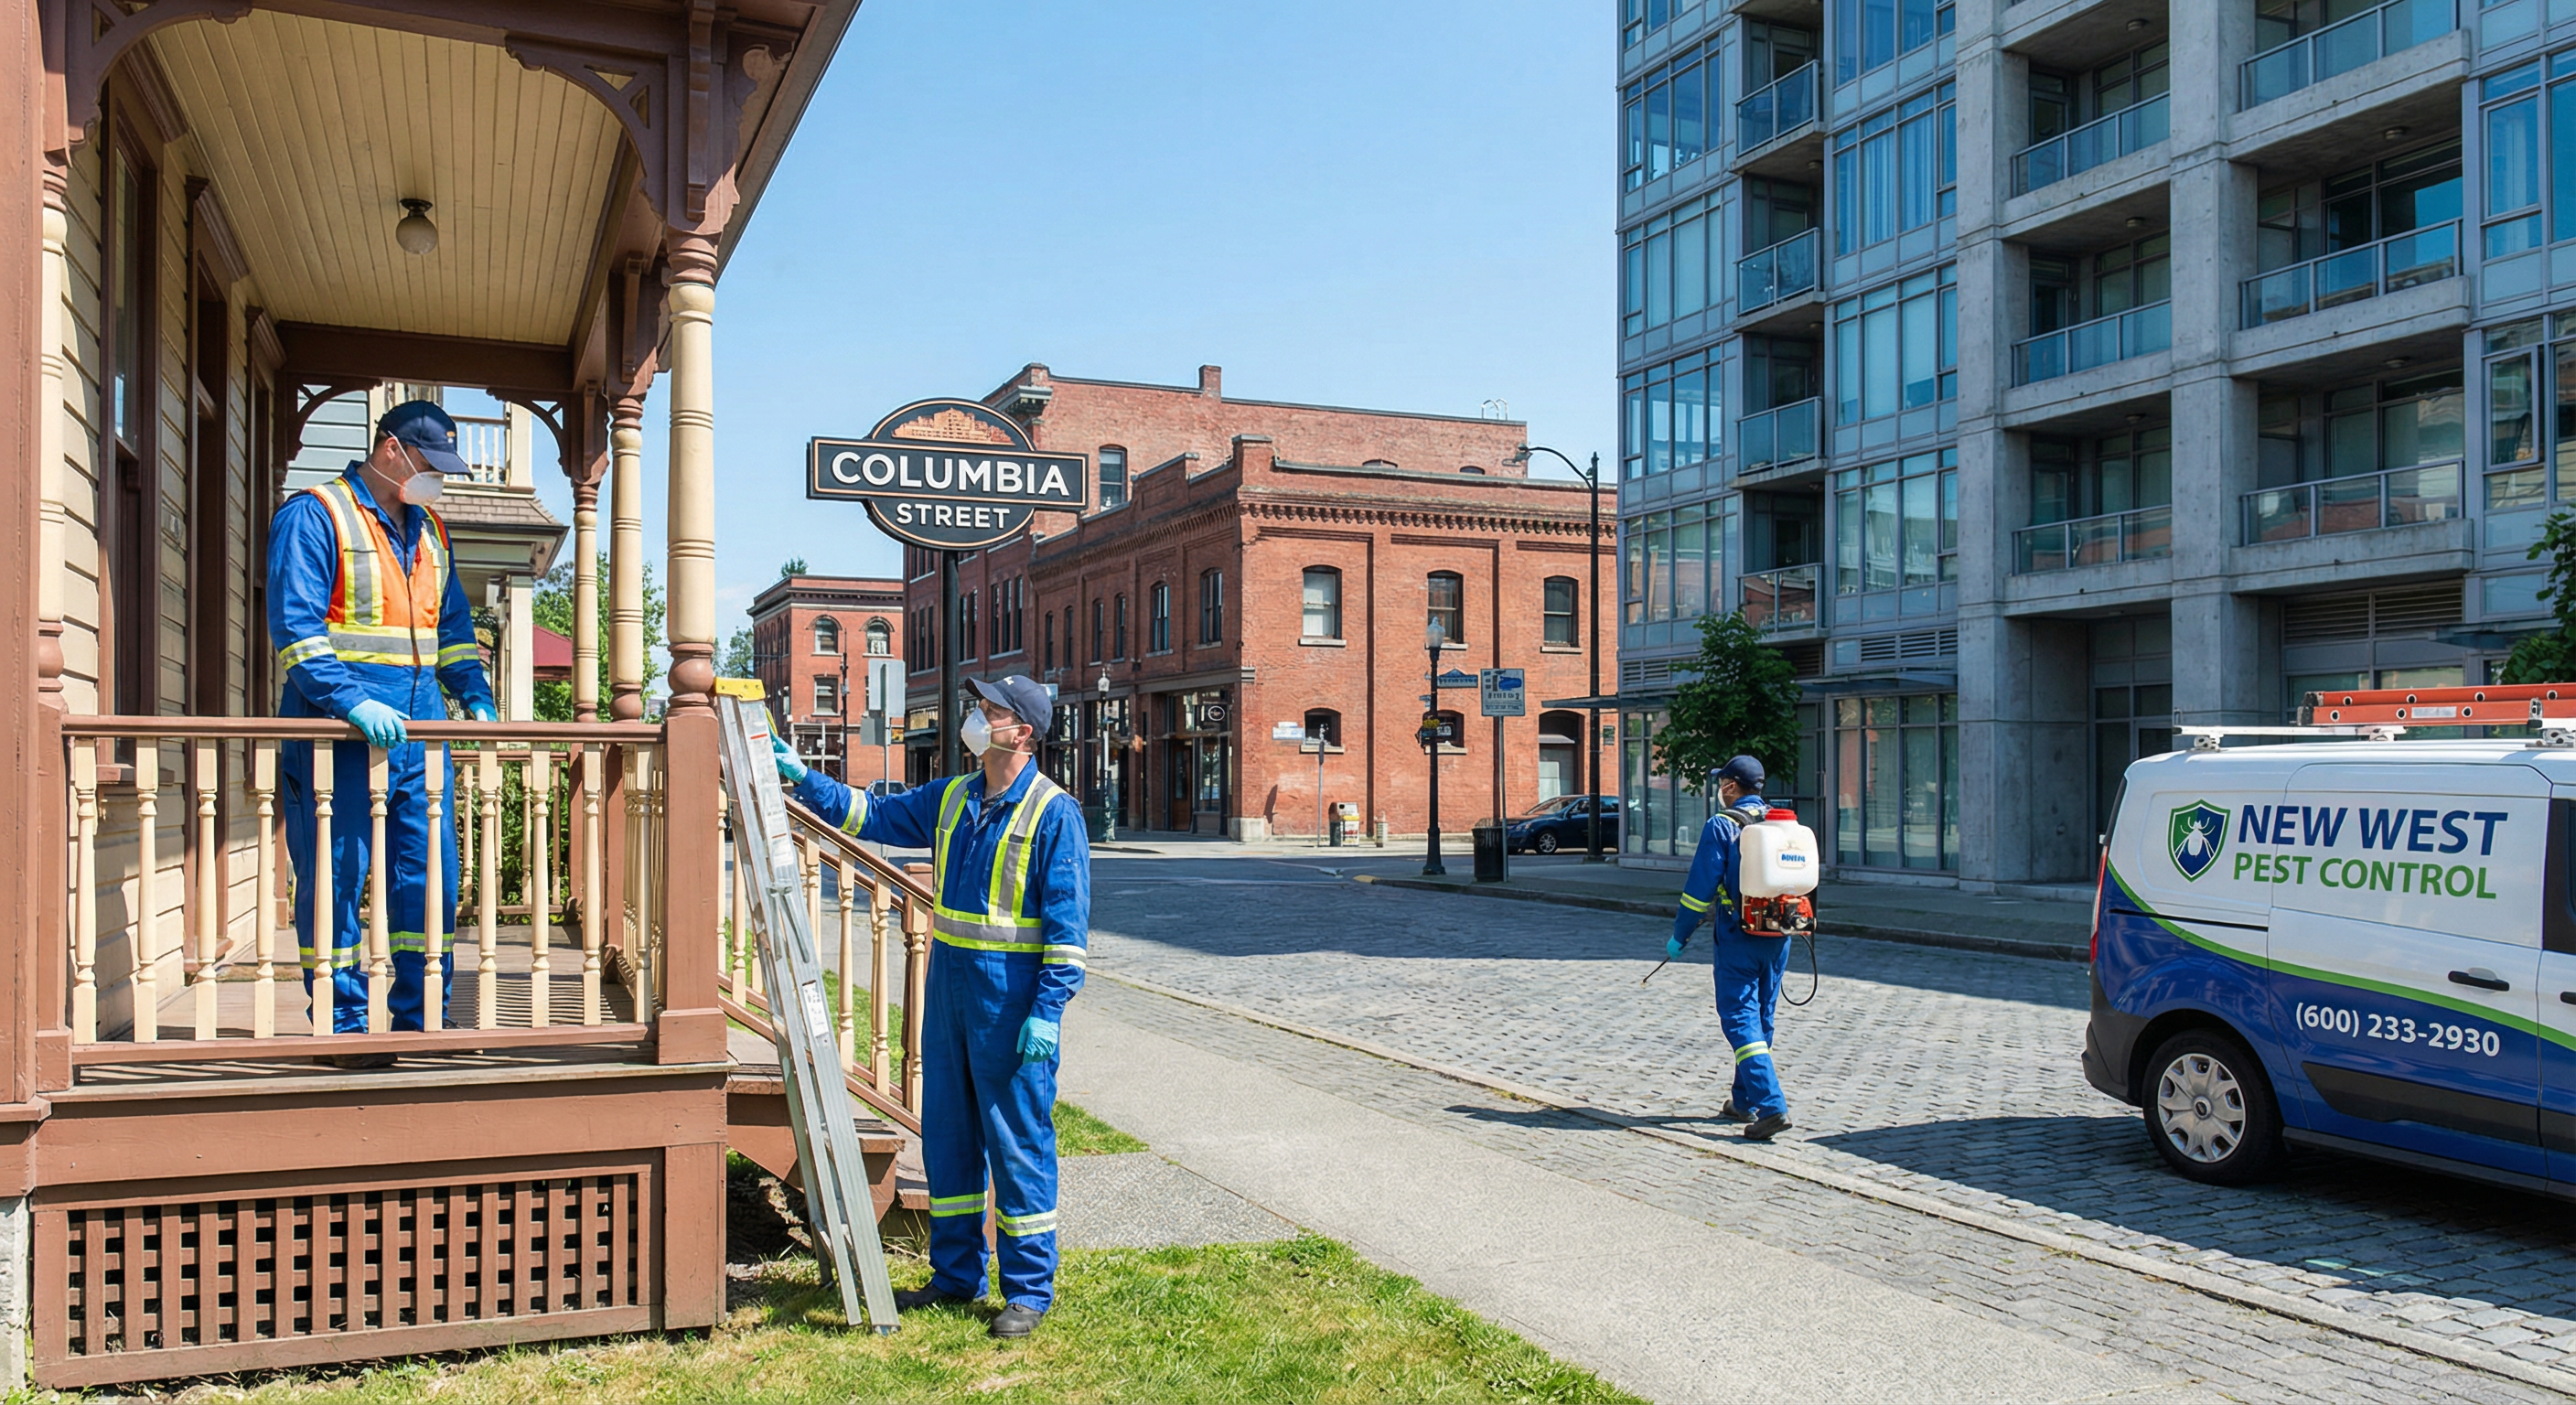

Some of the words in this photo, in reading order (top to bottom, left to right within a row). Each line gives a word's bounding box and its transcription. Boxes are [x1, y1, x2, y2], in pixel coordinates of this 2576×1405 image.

[832, 451, 1069, 497] COLUMBIA
[896, 502, 1010, 529] STREET
[2238, 804, 2348, 849] NEW
[2358, 808, 2508, 856] WEST
[2233, 853, 2313, 885] PEST
[2319, 857, 2497, 899] CONTROL
[2295, 1002, 2360, 1038] (600)
[2367, 1013, 2500, 1057] 233-2930
